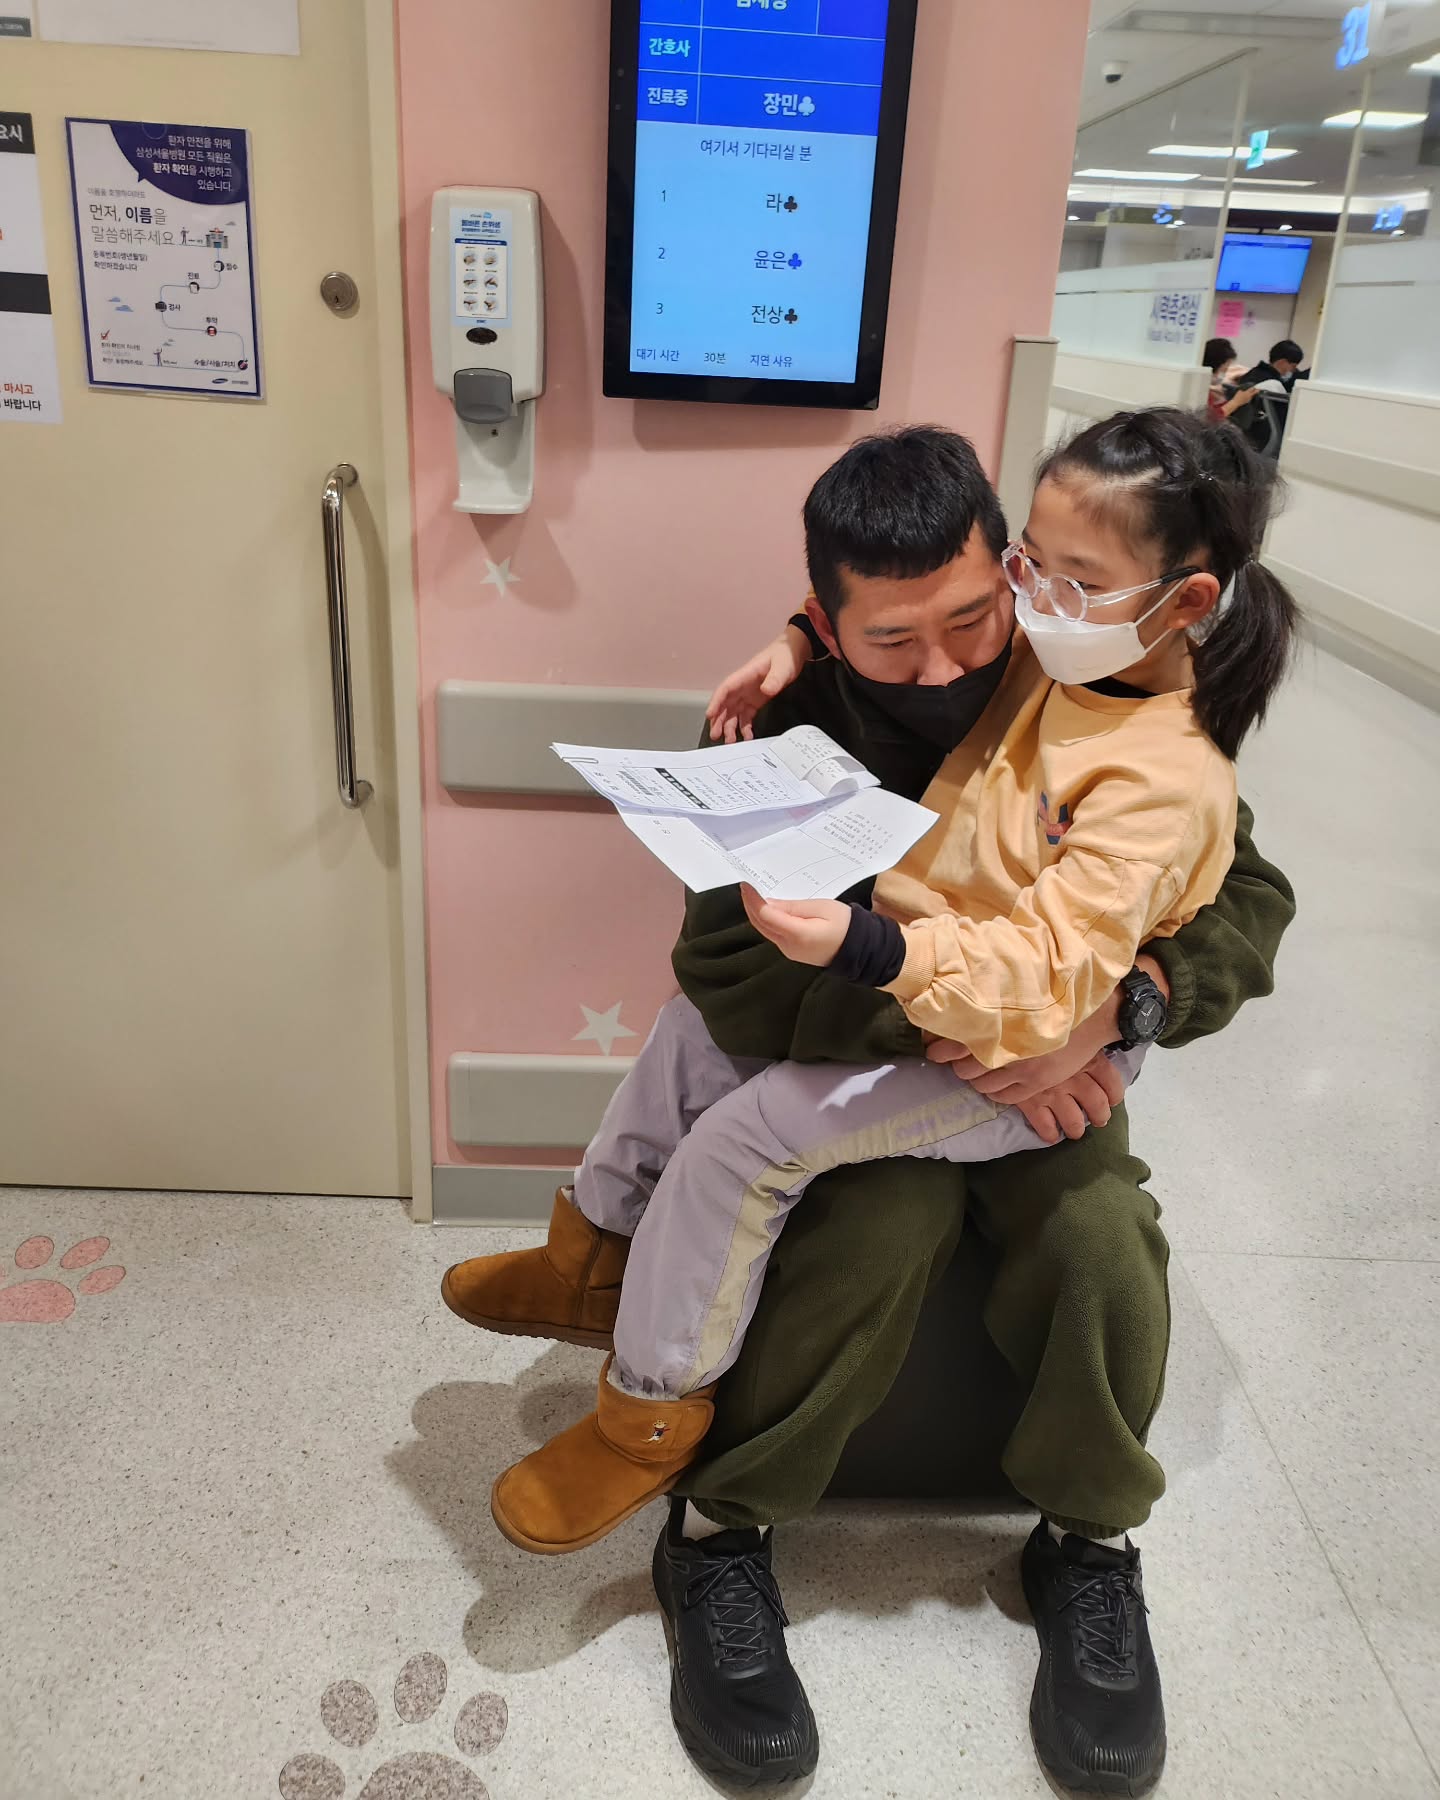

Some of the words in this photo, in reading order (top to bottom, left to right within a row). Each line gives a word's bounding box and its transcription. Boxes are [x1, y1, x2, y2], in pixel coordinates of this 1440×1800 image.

[1335, 1, 1371, 70] 31
[649, 38, 691, 57] 간호사
[647, 87, 689, 107] 진료중
[168, 135, 185, 146] 환자
[186, 136, 212, 148] 안전을
[213, 138, 232, 150] 위해
[700, 139, 739, 157] 여기서
[743, 142, 795, 161] 기다리실
[799, 145, 812, 162] 분
[135, 147, 187, 161] 삼성서울병원
[187, 150, 205, 162] 모든
[206, 152, 232, 164] 직원은
[153, 162, 170, 174] 환자
[172, 163, 197, 176] 확인을
[199, 166, 233, 178] 시행하고
[661, 190, 667, 202] 1
[766, 193, 783, 212] 라
[89, 204, 121, 222] 먼저,
[125, 206, 168, 226] 이름을
[91, 225, 175, 246] 말씀해주세요
[657, 247, 666, 260] 2
[754, 250, 787, 270] 윤은
[656, 302, 664, 315] 3
[751, 305, 783, 325] 전상
[636, 348, 656, 361] 대기
[660, 349, 680, 363] 시간
[703, 352, 727, 365] 30분
[750, 354, 770, 367] 지연
[773, 355, 793, 368] 사유
[4, 383, 35, 395] 마시고
[3, 398, 42, 411] 바랍니다
